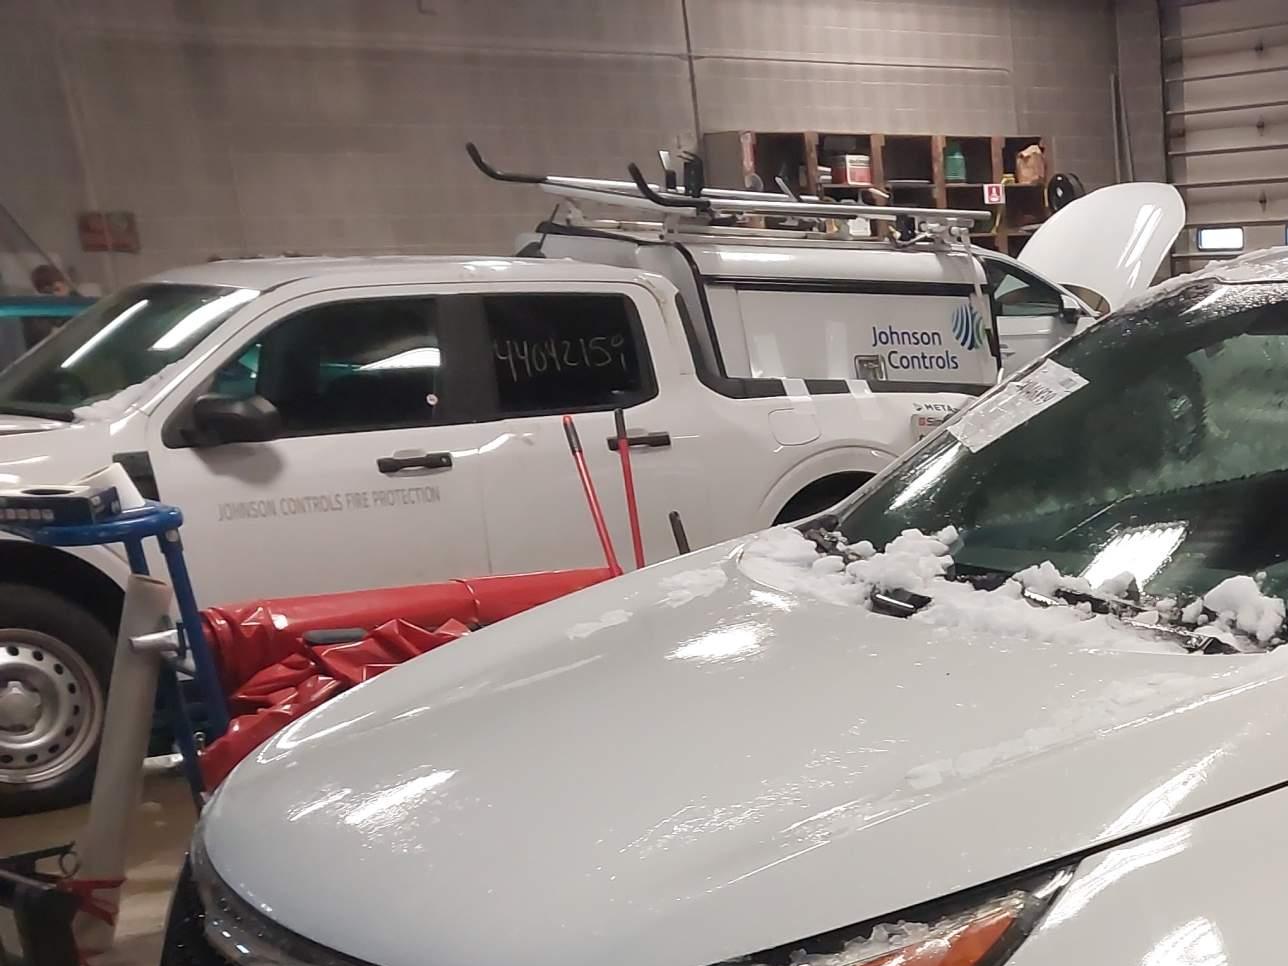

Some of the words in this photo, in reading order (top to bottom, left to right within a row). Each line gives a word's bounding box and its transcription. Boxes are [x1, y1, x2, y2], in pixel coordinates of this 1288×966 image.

[871, 325, 942, 347] Johnson
[494, 334, 626, 383] 44042159
[887, 350, 960, 370] Controls
[217, 500, 278, 521] JOHNSON
[280, 494, 343, 516] CONTROLS
[345, 492, 371, 509] FIRE
[372, 486, 441, 507] PROTECTION
